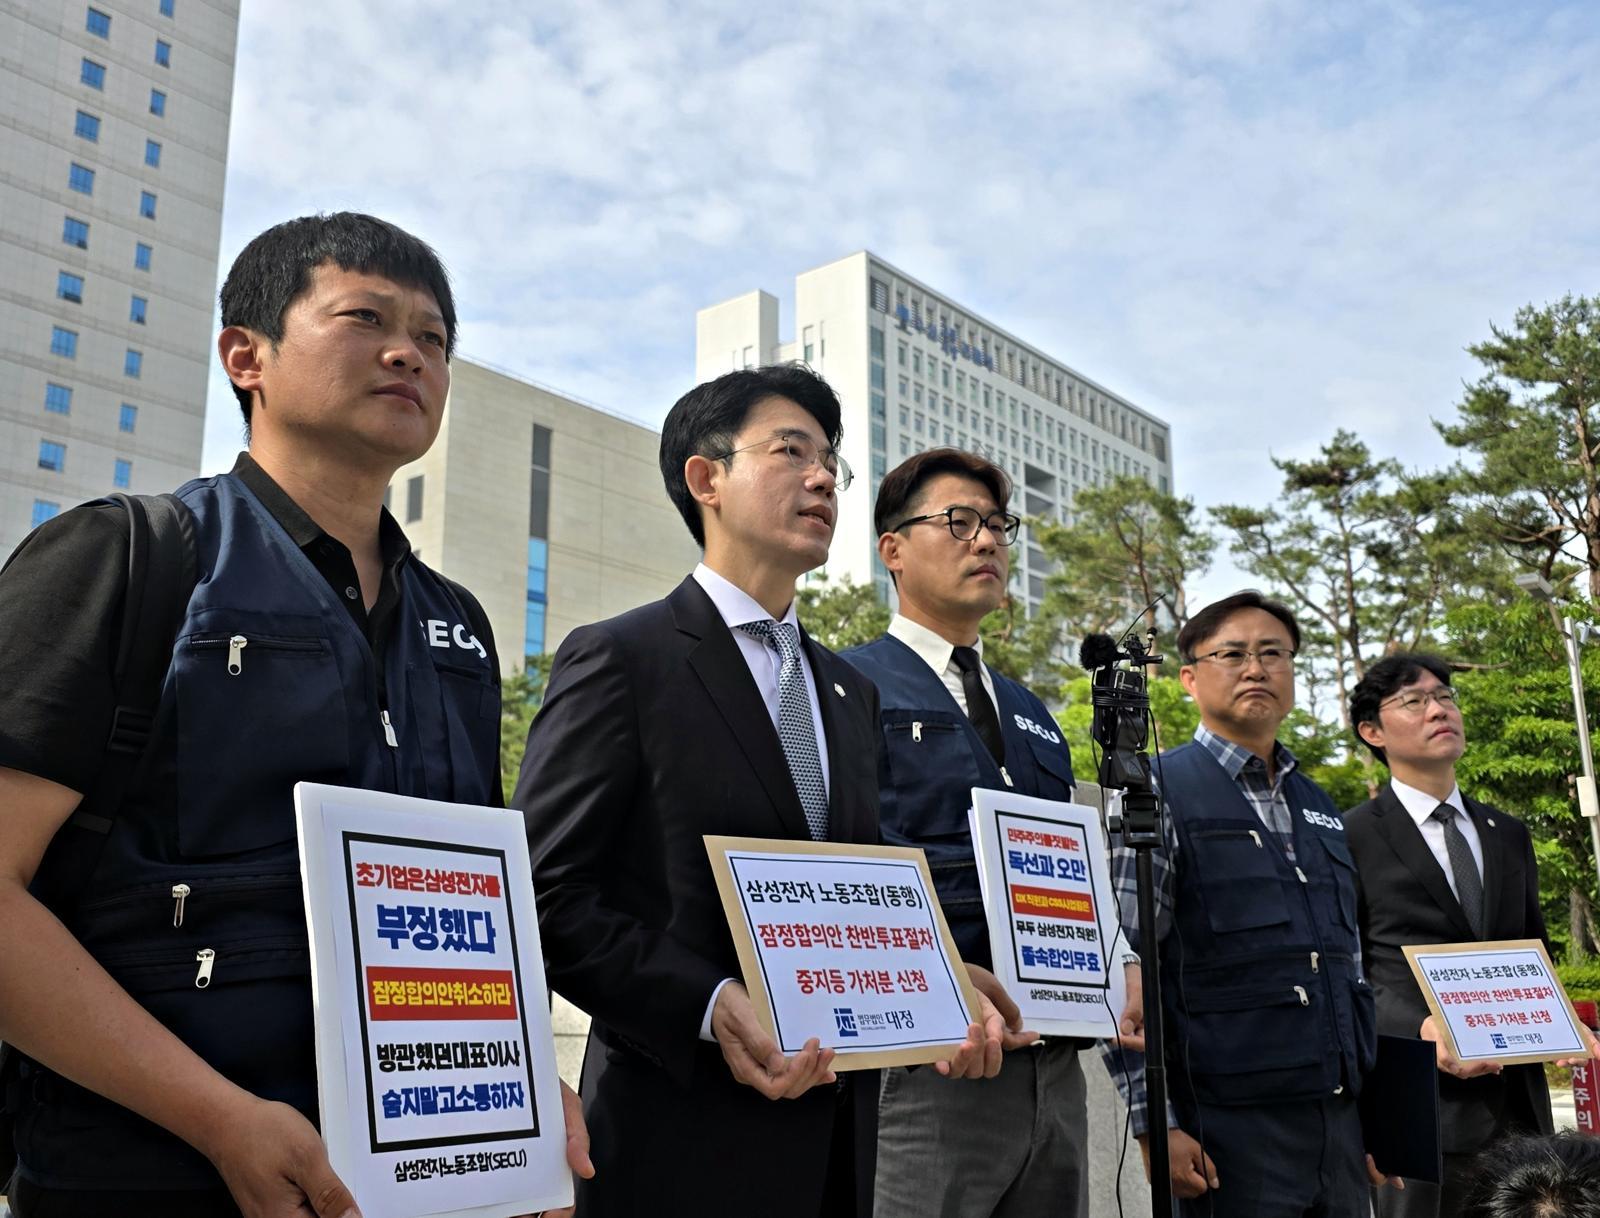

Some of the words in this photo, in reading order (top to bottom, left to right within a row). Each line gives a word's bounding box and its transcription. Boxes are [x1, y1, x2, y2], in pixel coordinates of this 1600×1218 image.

[419, 619, 487, 659] EC
[1014, 714, 1060, 744] SECU
[1302, 808, 1344, 831] SECU
[356, 862, 501, 898] 초기업은삼성전자를
[1008, 850, 1055, 878] 독선과
[1057, 858, 1087, 882] 오만
[746, 880, 817, 904] 삼성전자
[817, 883, 923, 909] 노동조합(동행)
[376, 904, 497, 954] 부정했다
[757, 923, 844, 949] 잠정합의안
[844, 925, 935, 951] 찬반투표절차
[1037, 922, 1075, 940] 삼성전자
[796, 968, 846, 995] 중지등
[846, 969, 896, 995] 가처분
[896, 968, 929, 993] 신청
[1429, 967, 1471, 982] 삼성전자
[1471, 963, 1544, 980] 노동조합(동행)
[372, 980, 512, 1006] 잠정합의안취소하라
[1439, 990, 1492, 1005] 잠정합의안
[1492, 986, 1555, 1003] 찬반투표절차
[884, 1010, 915, 1030] 대정
[1464, 1013, 1497, 1028] 중지등
[1496, 1011, 1530, 1026] 가처분
[1530, 1009, 1553, 1024] 신청
[381, 1081, 525, 1119] 숨지말고소통하자
[394, 1148, 527, 1183] 삼성전자노동조합(SECU)
